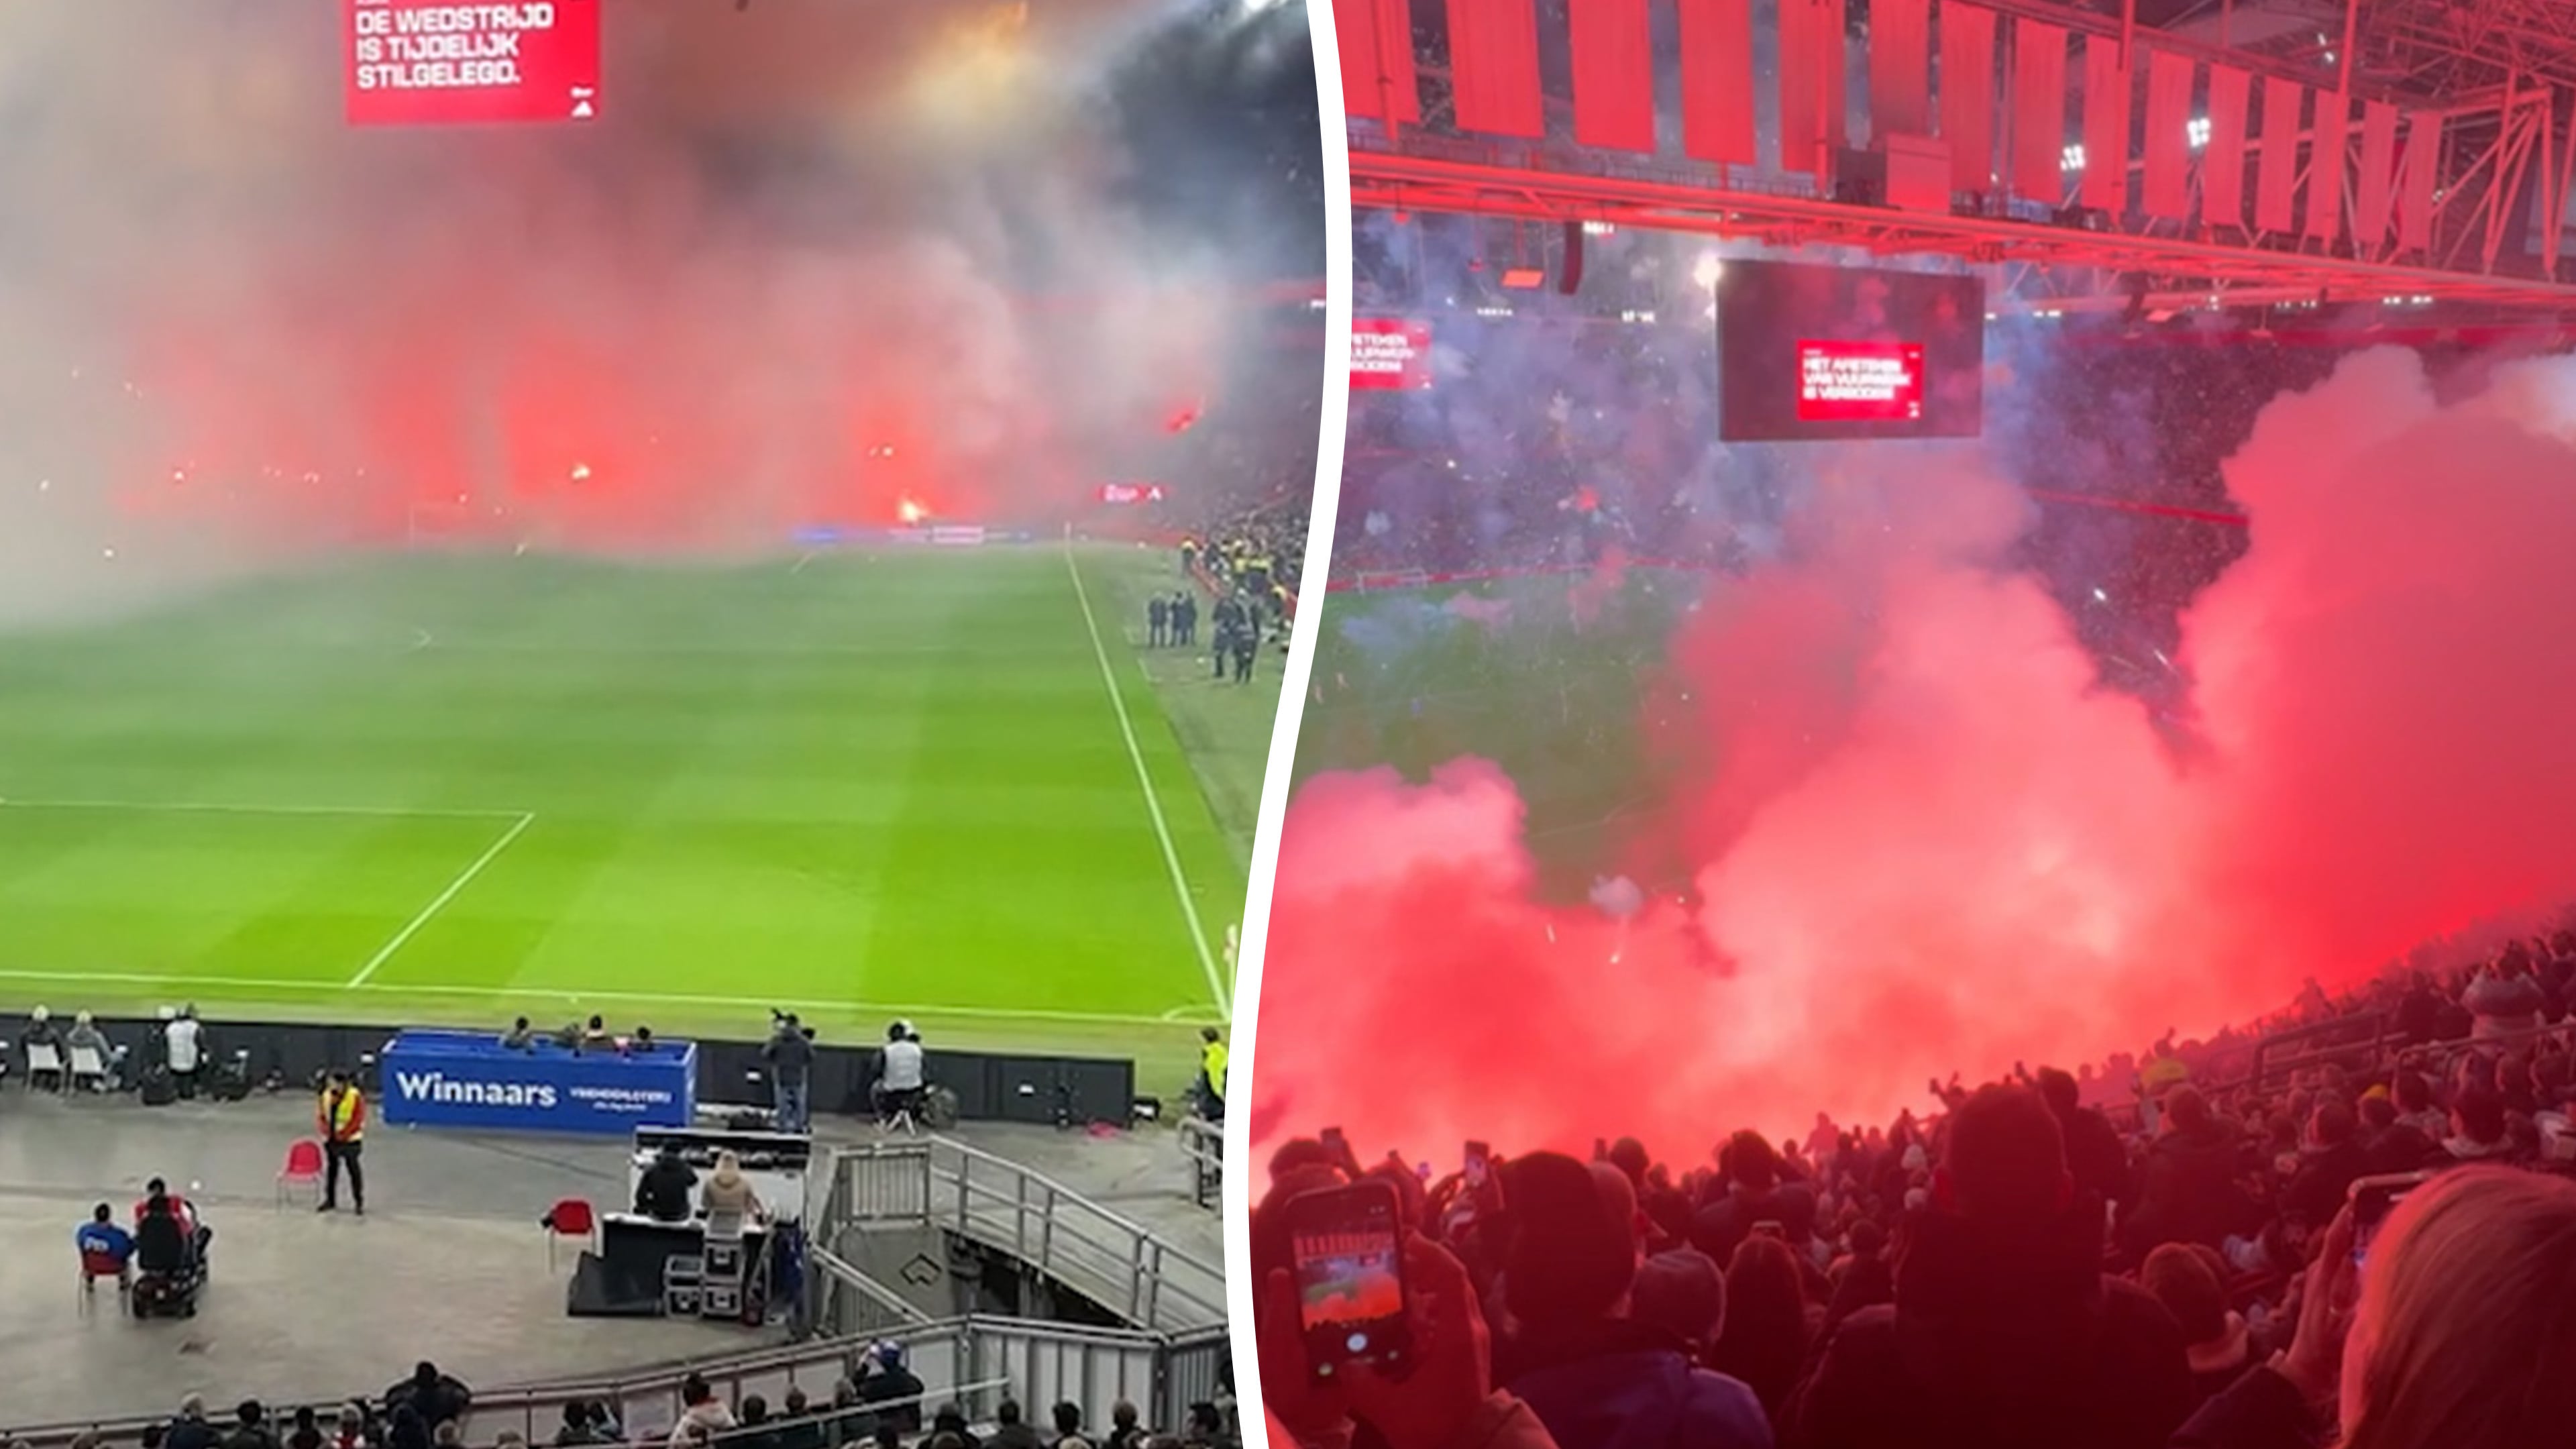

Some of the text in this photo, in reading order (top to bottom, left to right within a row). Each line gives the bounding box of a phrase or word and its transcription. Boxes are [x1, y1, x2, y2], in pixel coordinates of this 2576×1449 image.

[356, 3, 555, 35] DE WEDSTRIJD
[356, 32, 520, 62] IS TIJDELIJK
[357, 60, 522, 89] STILGELEGD.
[1803, 357, 1830, 372] HET
[1803, 372, 1835, 386] VAN
[1803, 386, 1817, 400] IS
[396, 1072, 557, 1107] Winnaars
